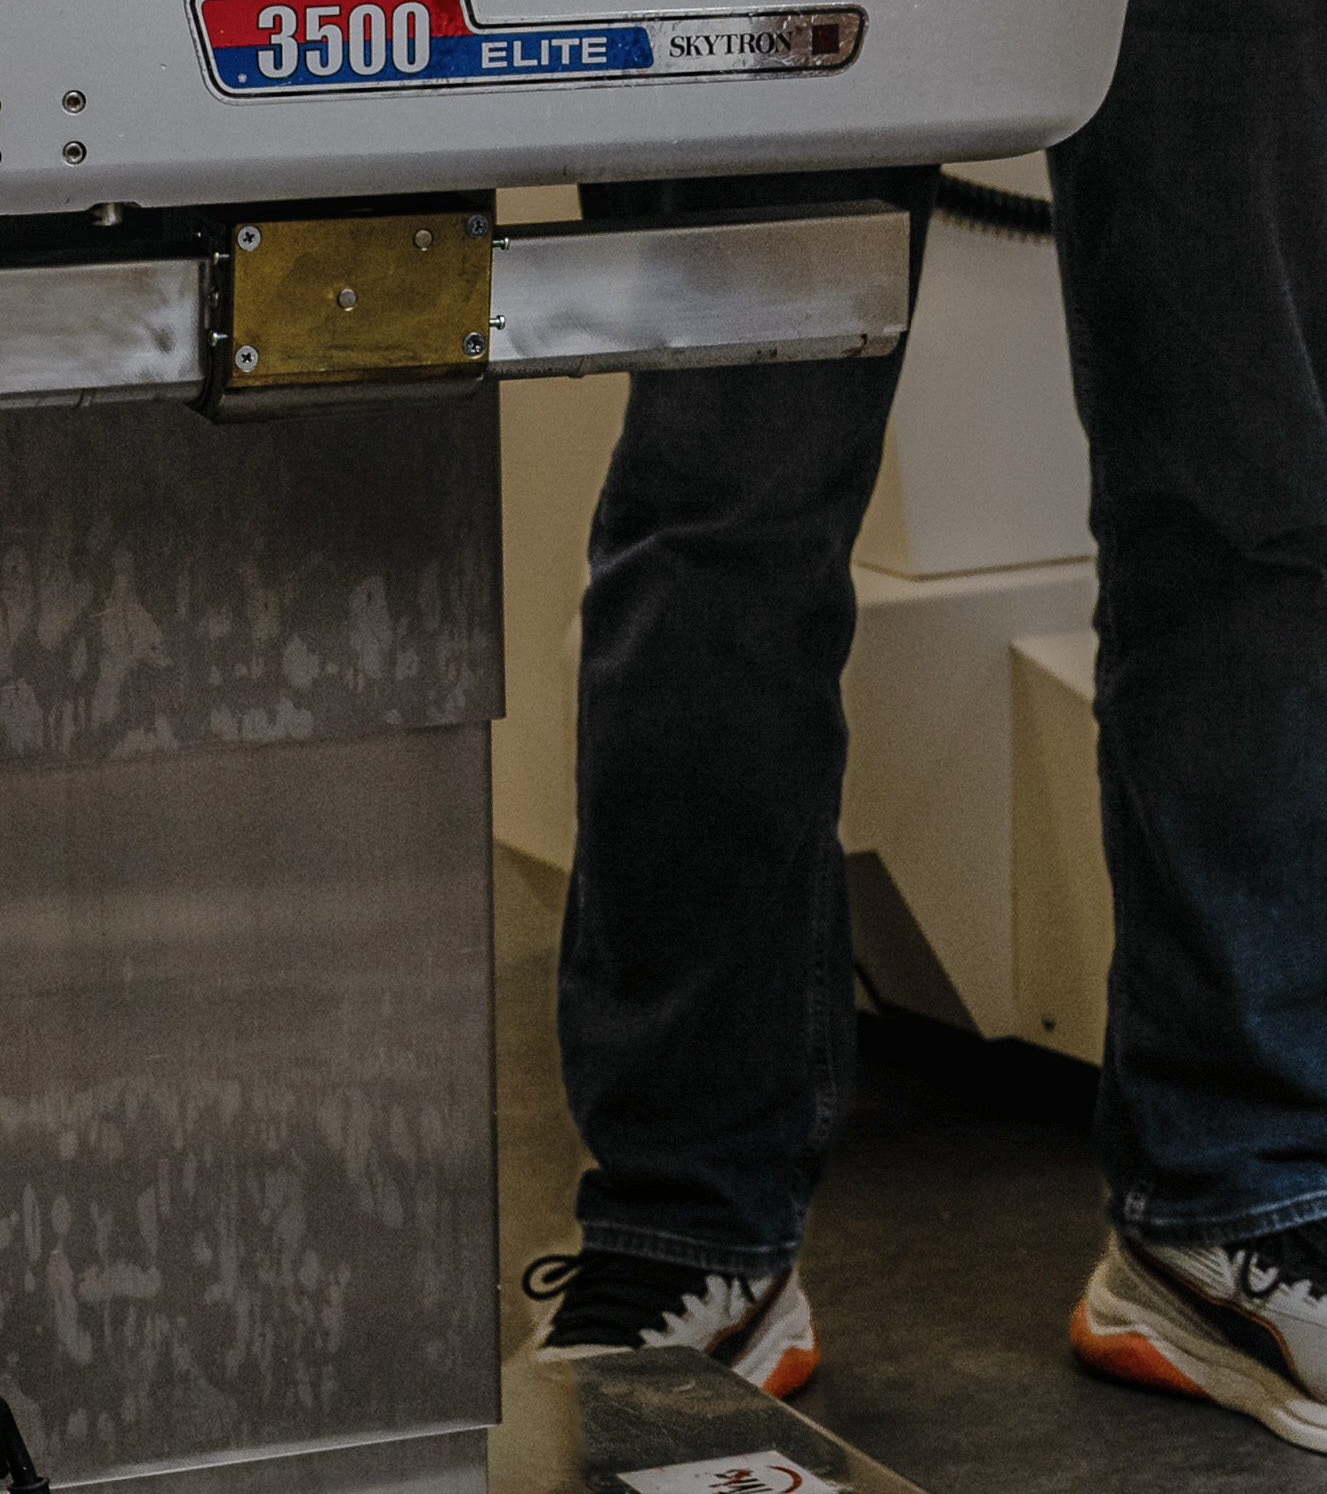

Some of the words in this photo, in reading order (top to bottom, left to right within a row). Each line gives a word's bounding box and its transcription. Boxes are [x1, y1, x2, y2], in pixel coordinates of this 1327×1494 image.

[256, 0, 431, 80] 3500
[481, 36, 608, 70] ELITE
[668, 30, 794, 59] SKYTRON
